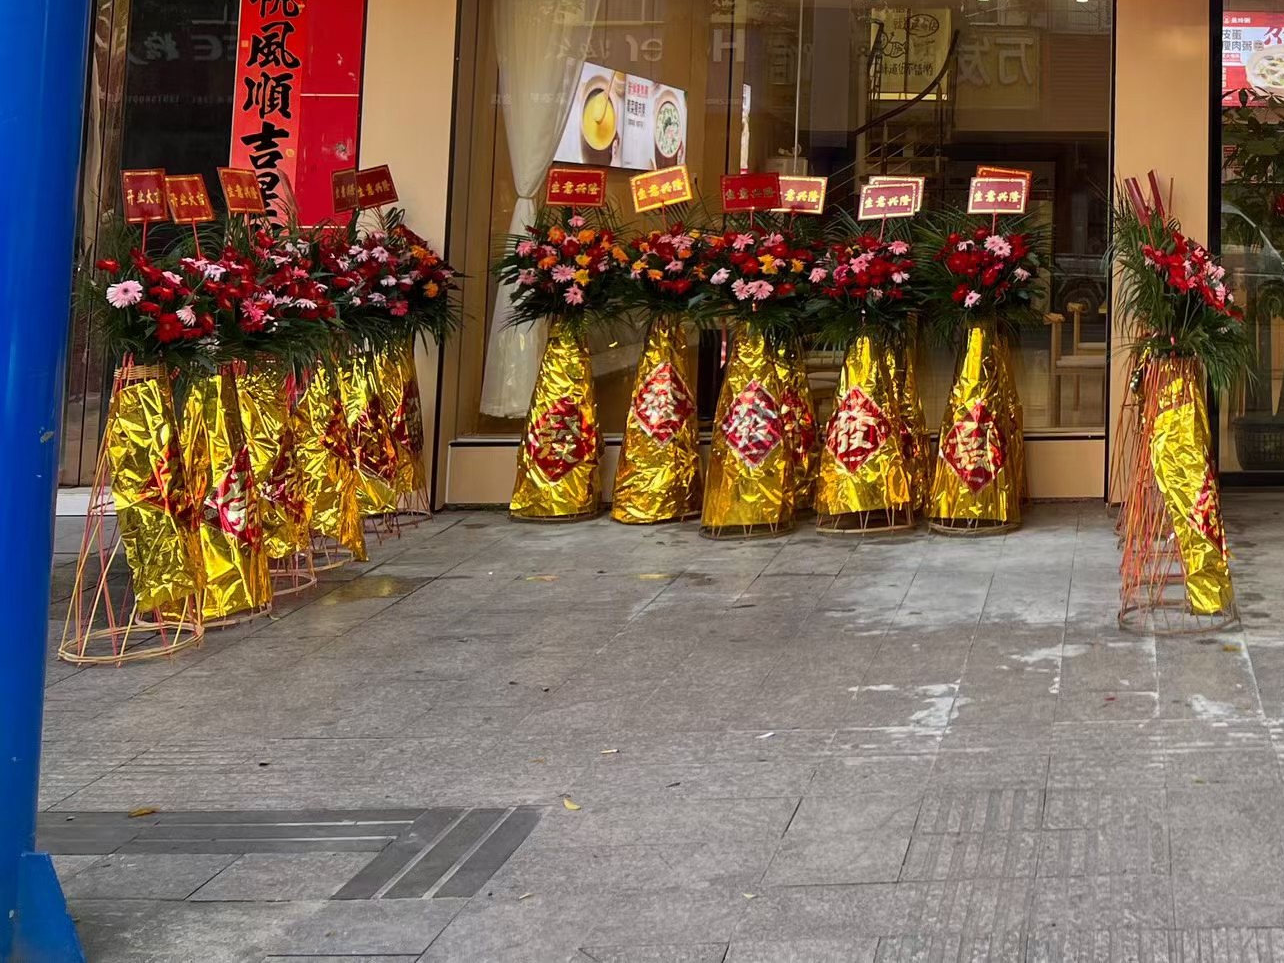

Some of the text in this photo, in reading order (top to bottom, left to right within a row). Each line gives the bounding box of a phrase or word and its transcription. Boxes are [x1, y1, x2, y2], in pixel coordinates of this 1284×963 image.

[550, 181, 601, 196] 生意兴隆
[637, 178, 684, 200] 生意兴隆
[972, 189, 1023, 203] 生意兴隆
[126, 188, 161, 206] 开业大吉
[169, 193, 205, 207] 开业大吉
[863, 193, 912, 209] 生意兴隆
